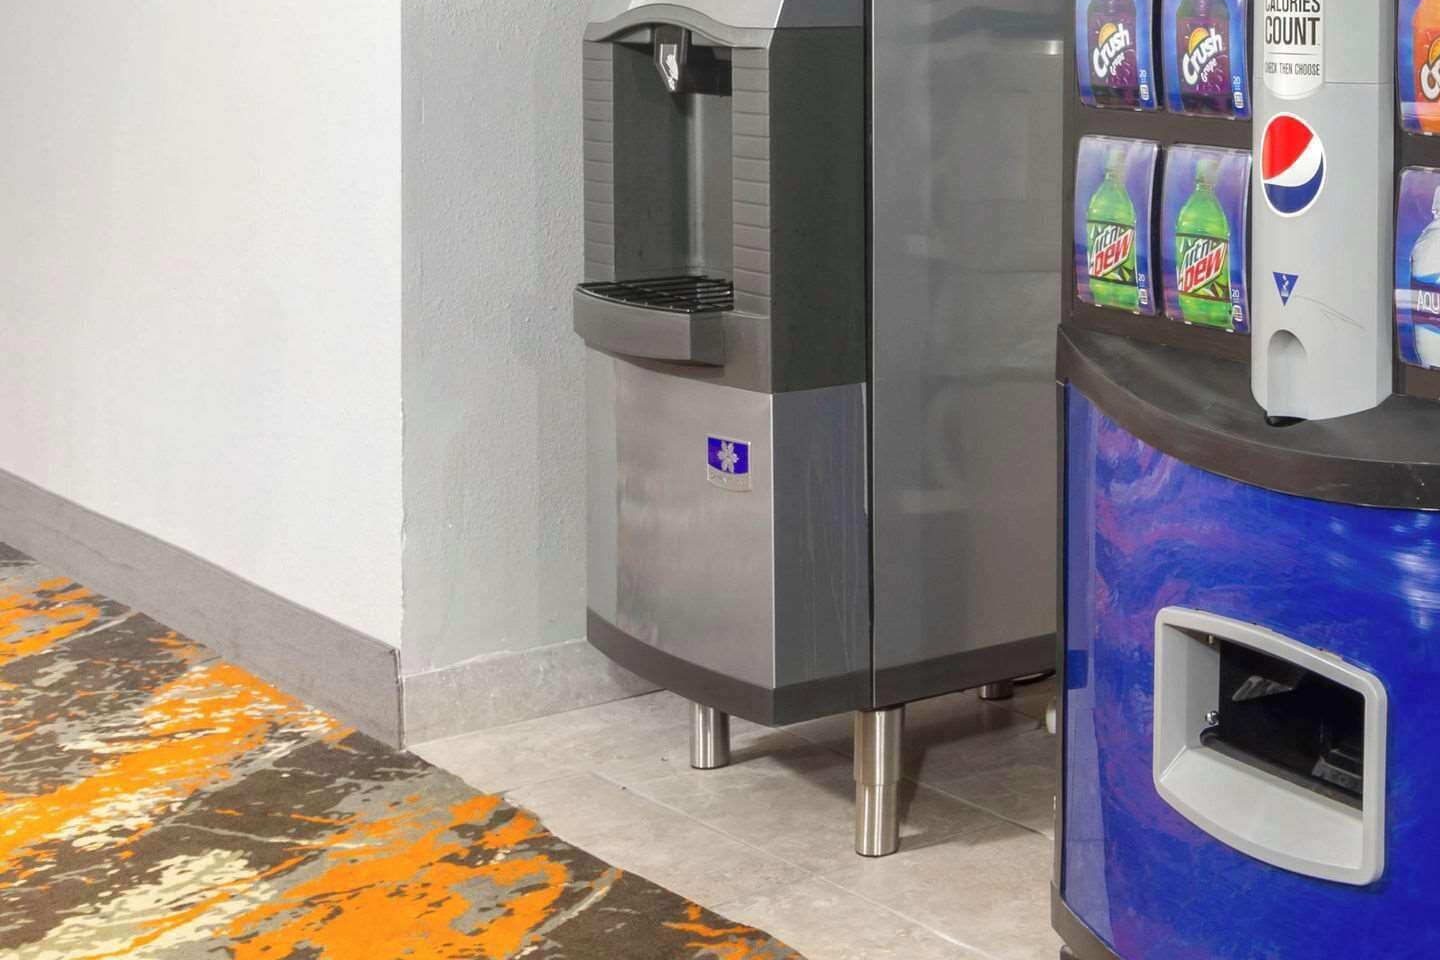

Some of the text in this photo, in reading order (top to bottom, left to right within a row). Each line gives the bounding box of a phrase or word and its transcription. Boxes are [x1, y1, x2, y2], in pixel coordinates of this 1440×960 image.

[1265, 16, 1320, 45] COUNT
[1093, 23, 1130, 78] Crush
[1182, 27, 1223, 85] Crush
[1295, 63, 1320, 76] CHOOSE
[1231, 288, 1240, 297] 20
